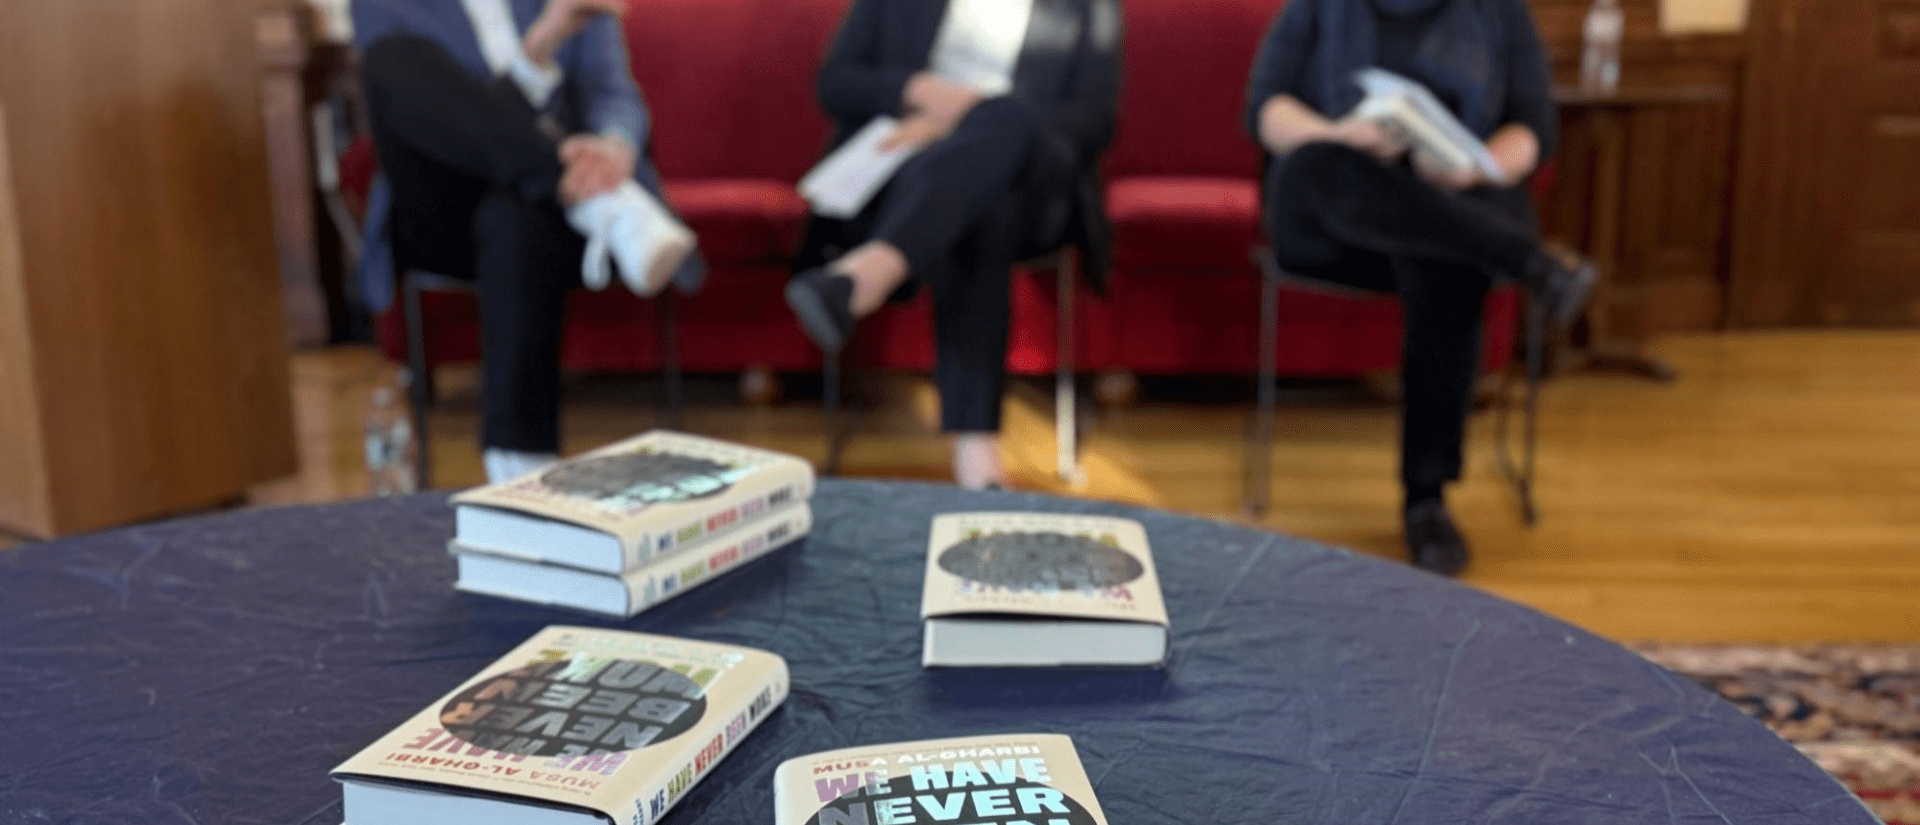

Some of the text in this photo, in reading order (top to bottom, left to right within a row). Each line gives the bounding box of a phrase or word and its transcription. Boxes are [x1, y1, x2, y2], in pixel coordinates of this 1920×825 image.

[474, 679, 692, 724] BEEN
[440, 702, 663, 748] NEVER
[386, 753, 522, 775] AL-GHARBI
[402, 727, 629, 776] WE HAVE
[813, 757, 887, 774] MUSA
[898, 746, 1039, 763] AL-GHARBI
[529, 770, 601, 790] MUSA
[650, 788, 665, 820] WE
[667, 762, 692, 803] HAVE
[694, 733, 724, 775] NEVER
[814, 757, 1053, 802] WE HAVE
[818, 787, 1071, 825] NEVER
